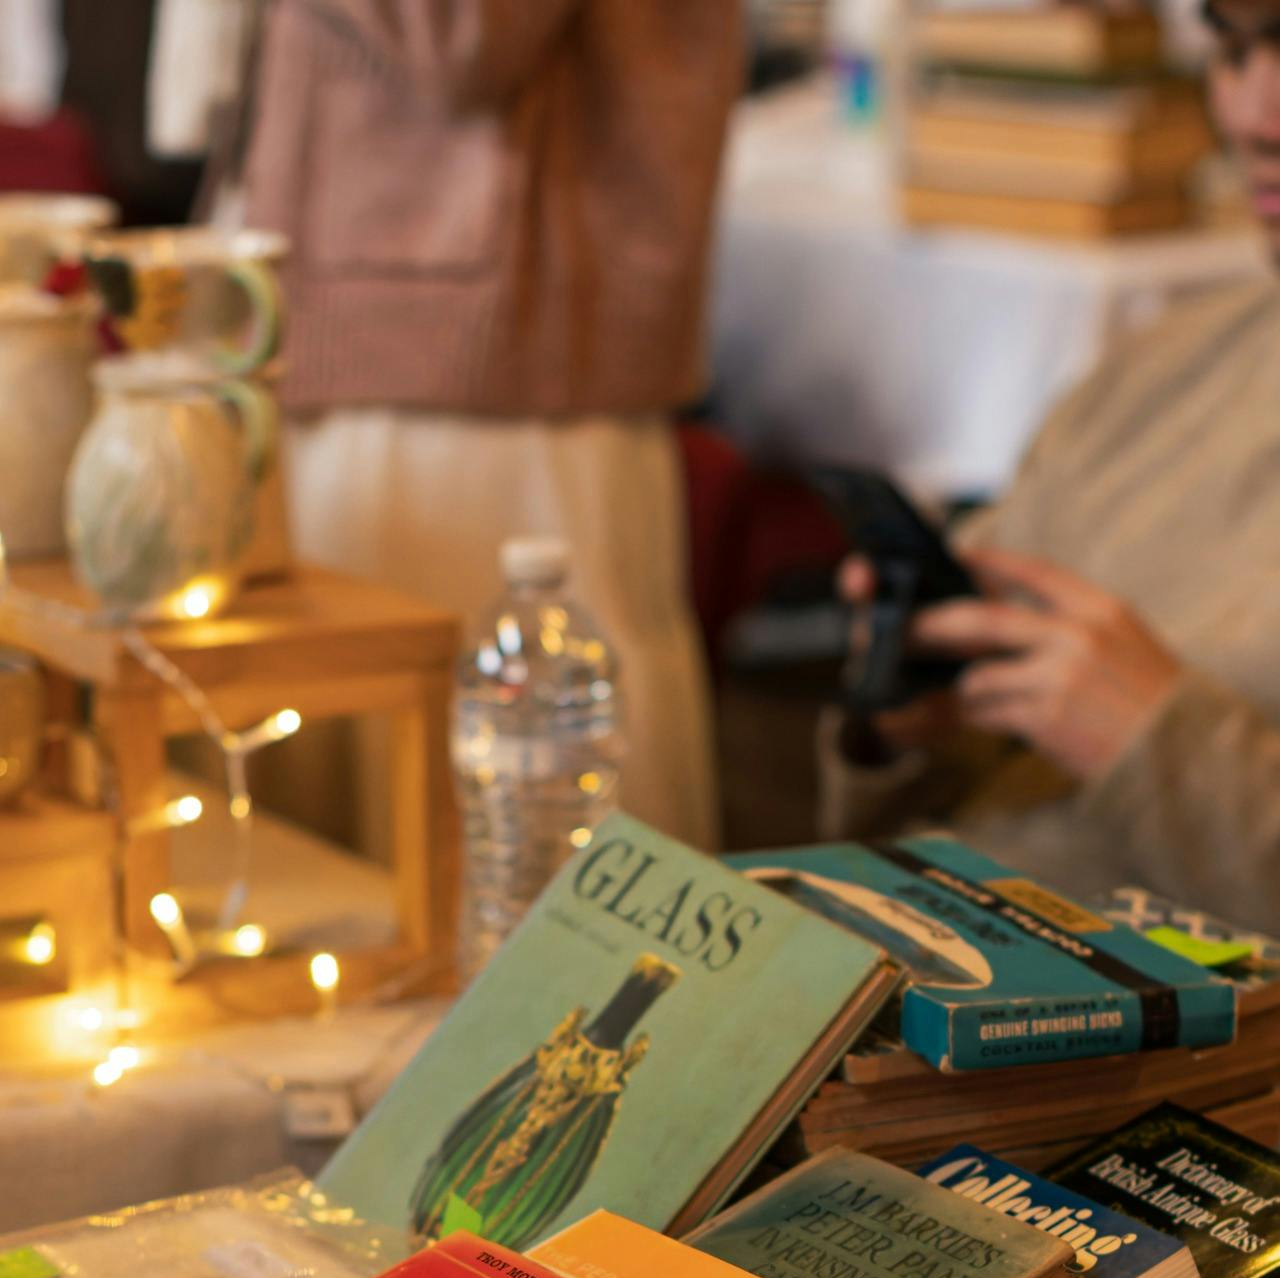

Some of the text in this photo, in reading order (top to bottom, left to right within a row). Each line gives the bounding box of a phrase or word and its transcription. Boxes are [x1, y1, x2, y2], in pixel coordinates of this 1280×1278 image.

[571, 837, 763, 972] GLASS
[981, 1022, 1028, 1041] GENUINE
[1088, 1153, 1267, 1253] British Antique Glass
[1156, 1147, 1256, 1206] Dictionary
[784, 1201, 894, 1265] PETER
[870, 1200, 1007, 1270] BARRIE'S
[925, 1156, 1138, 1273] Collecting
[476, 1251, 511, 1272] TROY
